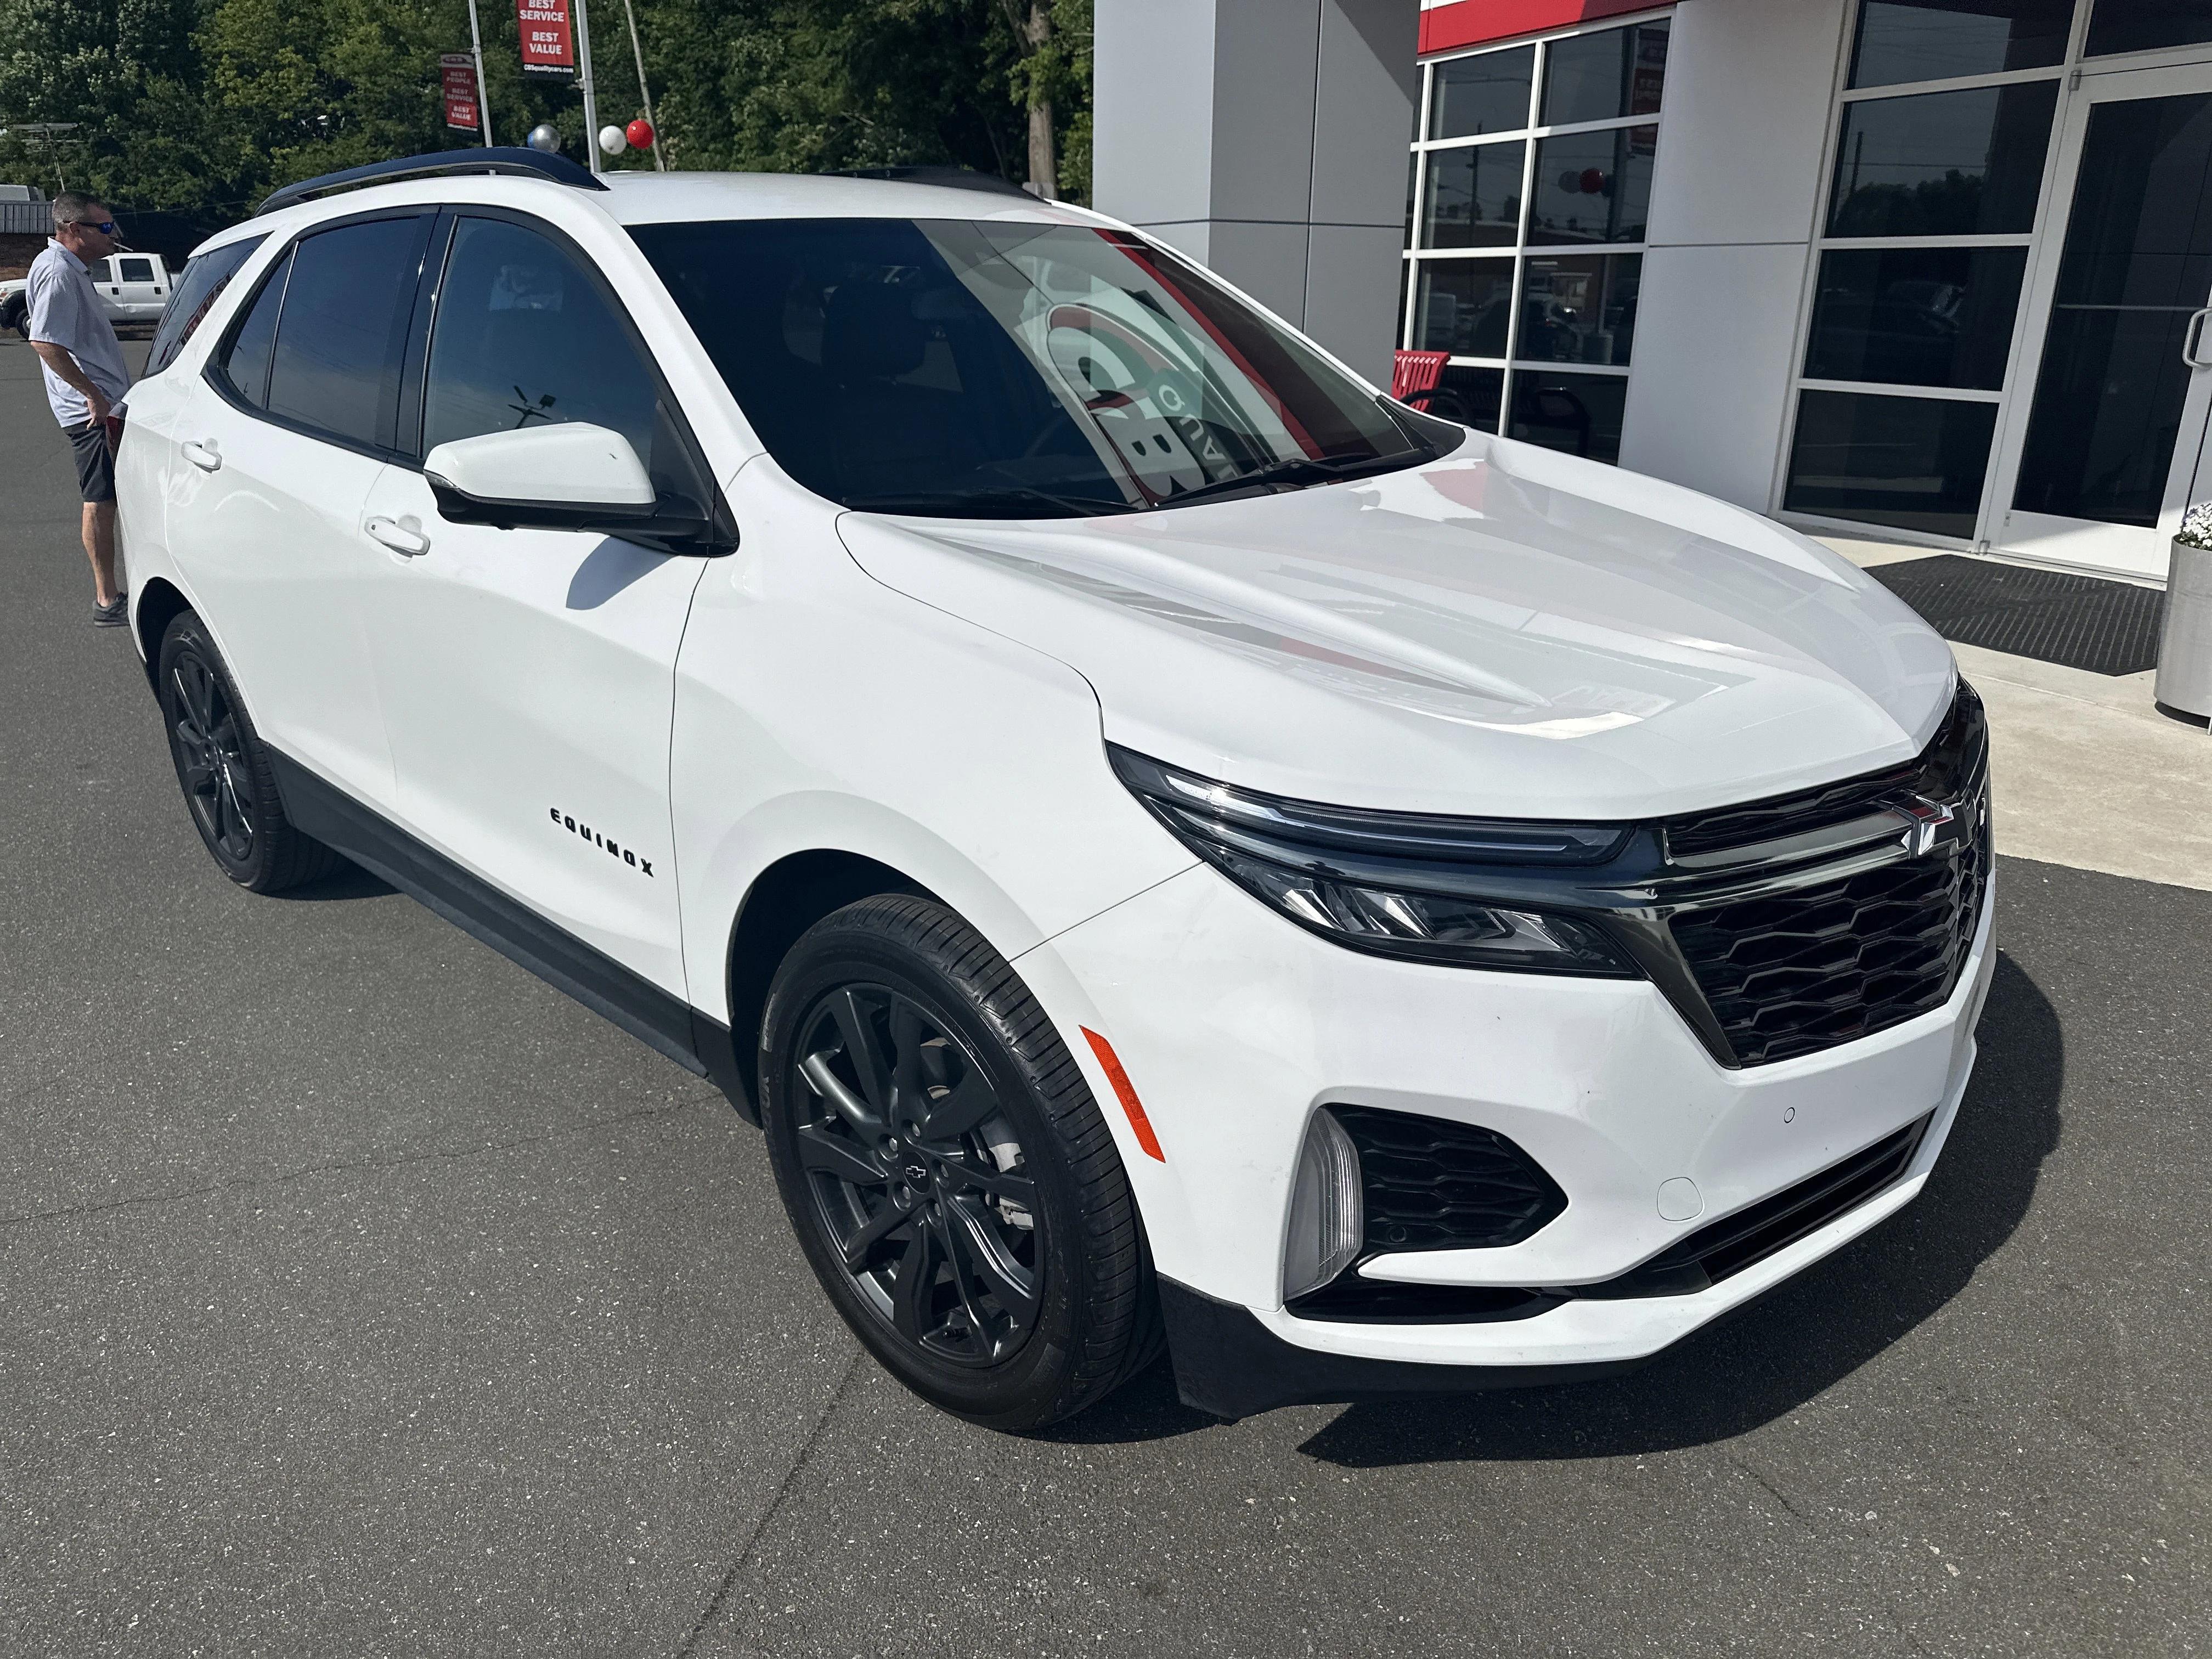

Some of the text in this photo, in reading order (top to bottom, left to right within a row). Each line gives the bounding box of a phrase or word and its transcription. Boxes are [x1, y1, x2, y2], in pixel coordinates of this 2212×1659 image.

[528, 0, 556, 9] BEST
[520, 9, 565, 22] SERVICE
[532, 31, 559, 42] BEST
[528, 43, 562, 55] VALUE
[453, 105, 470, 114] BEST
[452, 110, 472, 121] VALUE
[550, 808, 654, 878] EQUINOX
